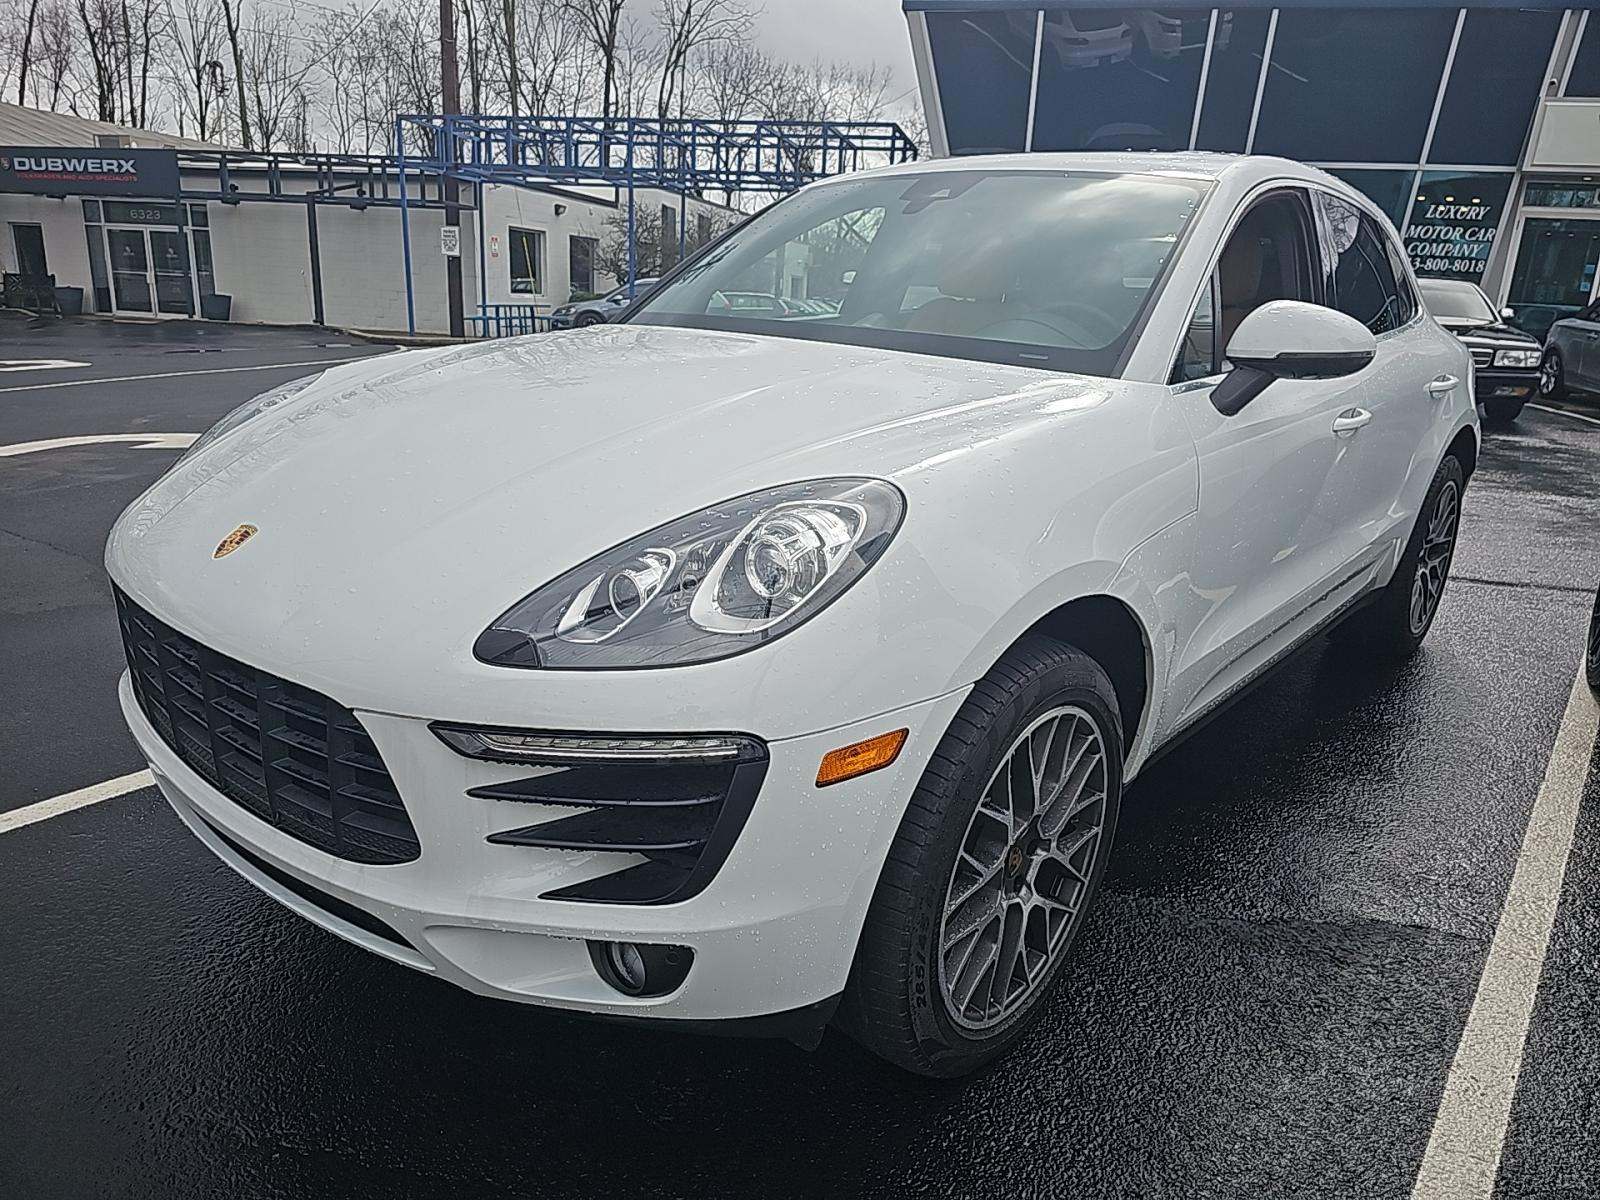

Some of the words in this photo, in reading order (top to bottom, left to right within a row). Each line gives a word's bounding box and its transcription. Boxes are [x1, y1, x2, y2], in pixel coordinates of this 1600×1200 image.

[13, 157, 137, 174] DUBWERX
[130, 209, 161, 220] 6323
[1425, 204, 1490, 220] LUXURY
[1406, 225, 1464, 240] MOTOR
[1465, 227, 1497, 242] CAR
[1407, 242, 1484, 257] COMPANY
[1409, 257, 1486, 273] 3-800-8018
